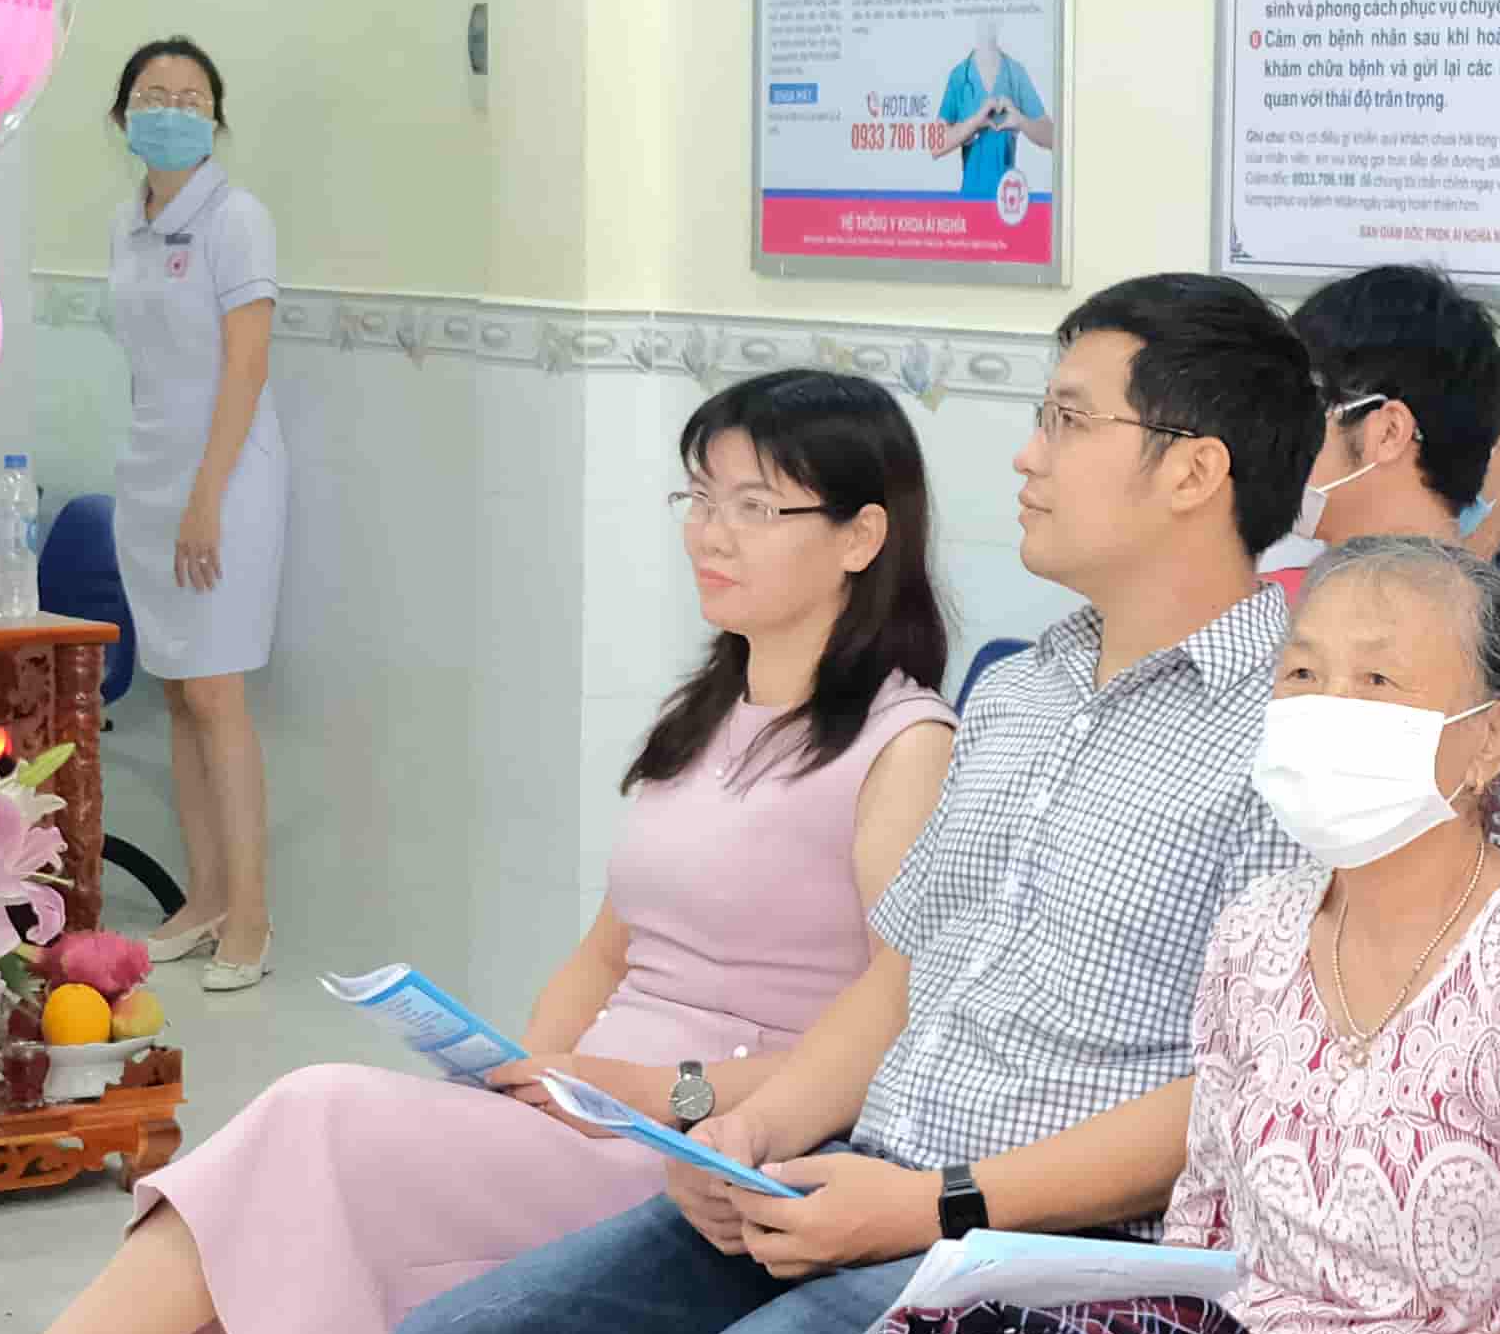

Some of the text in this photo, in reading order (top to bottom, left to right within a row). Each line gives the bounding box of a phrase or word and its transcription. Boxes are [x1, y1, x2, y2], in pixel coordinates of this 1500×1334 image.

[851, 122, 946, 150] 0933 706 188
